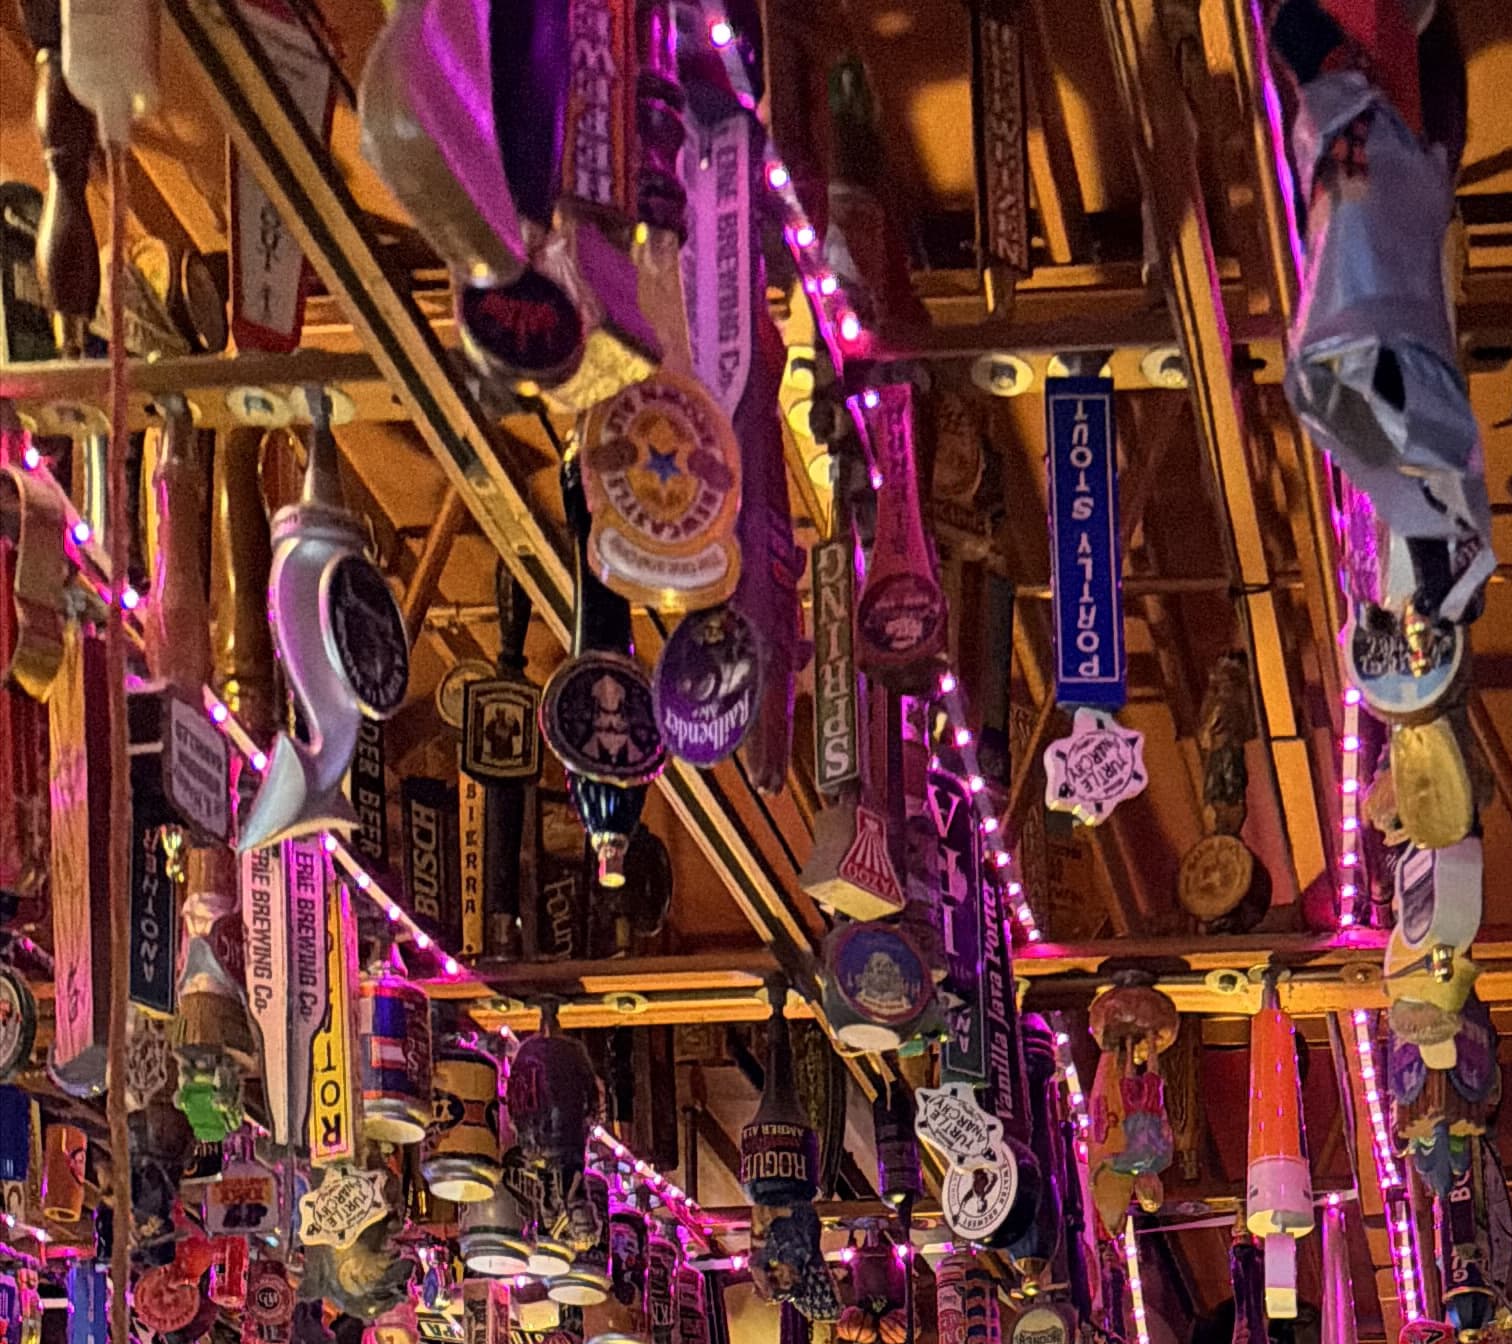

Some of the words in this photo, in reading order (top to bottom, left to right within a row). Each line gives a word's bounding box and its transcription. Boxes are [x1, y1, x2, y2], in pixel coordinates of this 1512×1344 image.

[714, 212, 739, 344] BREWING
[1071, 401, 1094, 520] STOUT
[1076, 532, 1100, 677] PORTLY
[820, 542, 852, 779] SPRING
[664, 698, 750, 750] Railbender
[1082, 754, 1130, 792] TURTLE
[358, 789, 383, 860] BEER
[411, 800, 440, 920] BUSCH
[464, 783, 479, 915] SIERRA
[141, 826, 161, 984] ANOTHER
[295, 852, 316, 904] ERIE
[848, 862, 900, 899] YAZOO
[248, 889, 273, 967] BREWING
[295, 909, 317, 993] BREWING
[985, 966, 1009, 1030] Java
[987, 1033, 1014, 1119] Vanilla
[928, 1107, 974, 1148] TURTLE
[743, 1151, 808, 1184] ROGUE
[327, 1188, 371, 1230] TURTLE
